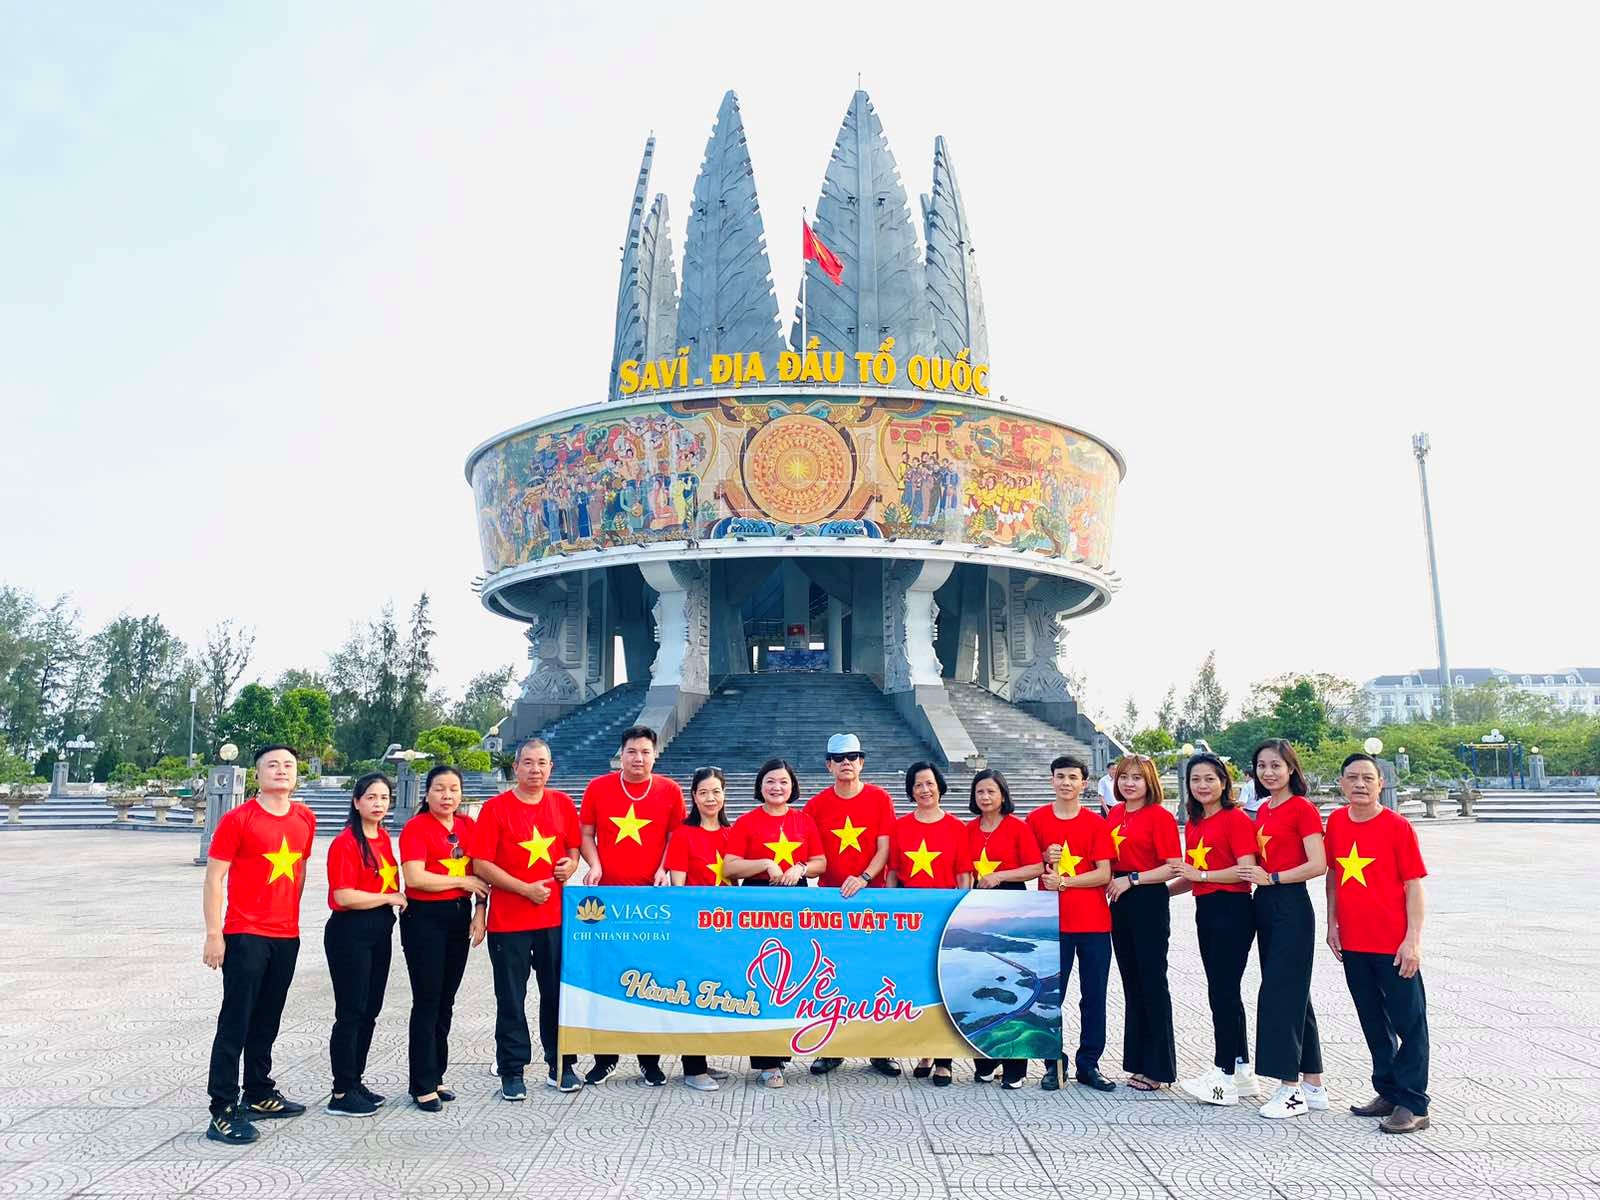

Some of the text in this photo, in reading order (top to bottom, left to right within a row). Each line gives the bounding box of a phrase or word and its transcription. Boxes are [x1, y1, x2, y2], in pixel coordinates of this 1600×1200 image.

[709, 351, 766, 388] ĐỊA
[777, 336, 845, 383] ĐẦU
[855, 336, 896, 384] TỔ
[907, 347, 990, 395] QUỐC
[611, 904, 671, 919] VIAGS
[698, 907, 923, 933] ĐỘI CUNG ỨNG VẬT TƯ
[573, 932, 591, 941] CHI
[620, 970, 761, 1016] Hành Trình
[746, 937, 839, 1006] Về
[790, 976, 923, 1055] nguồn
